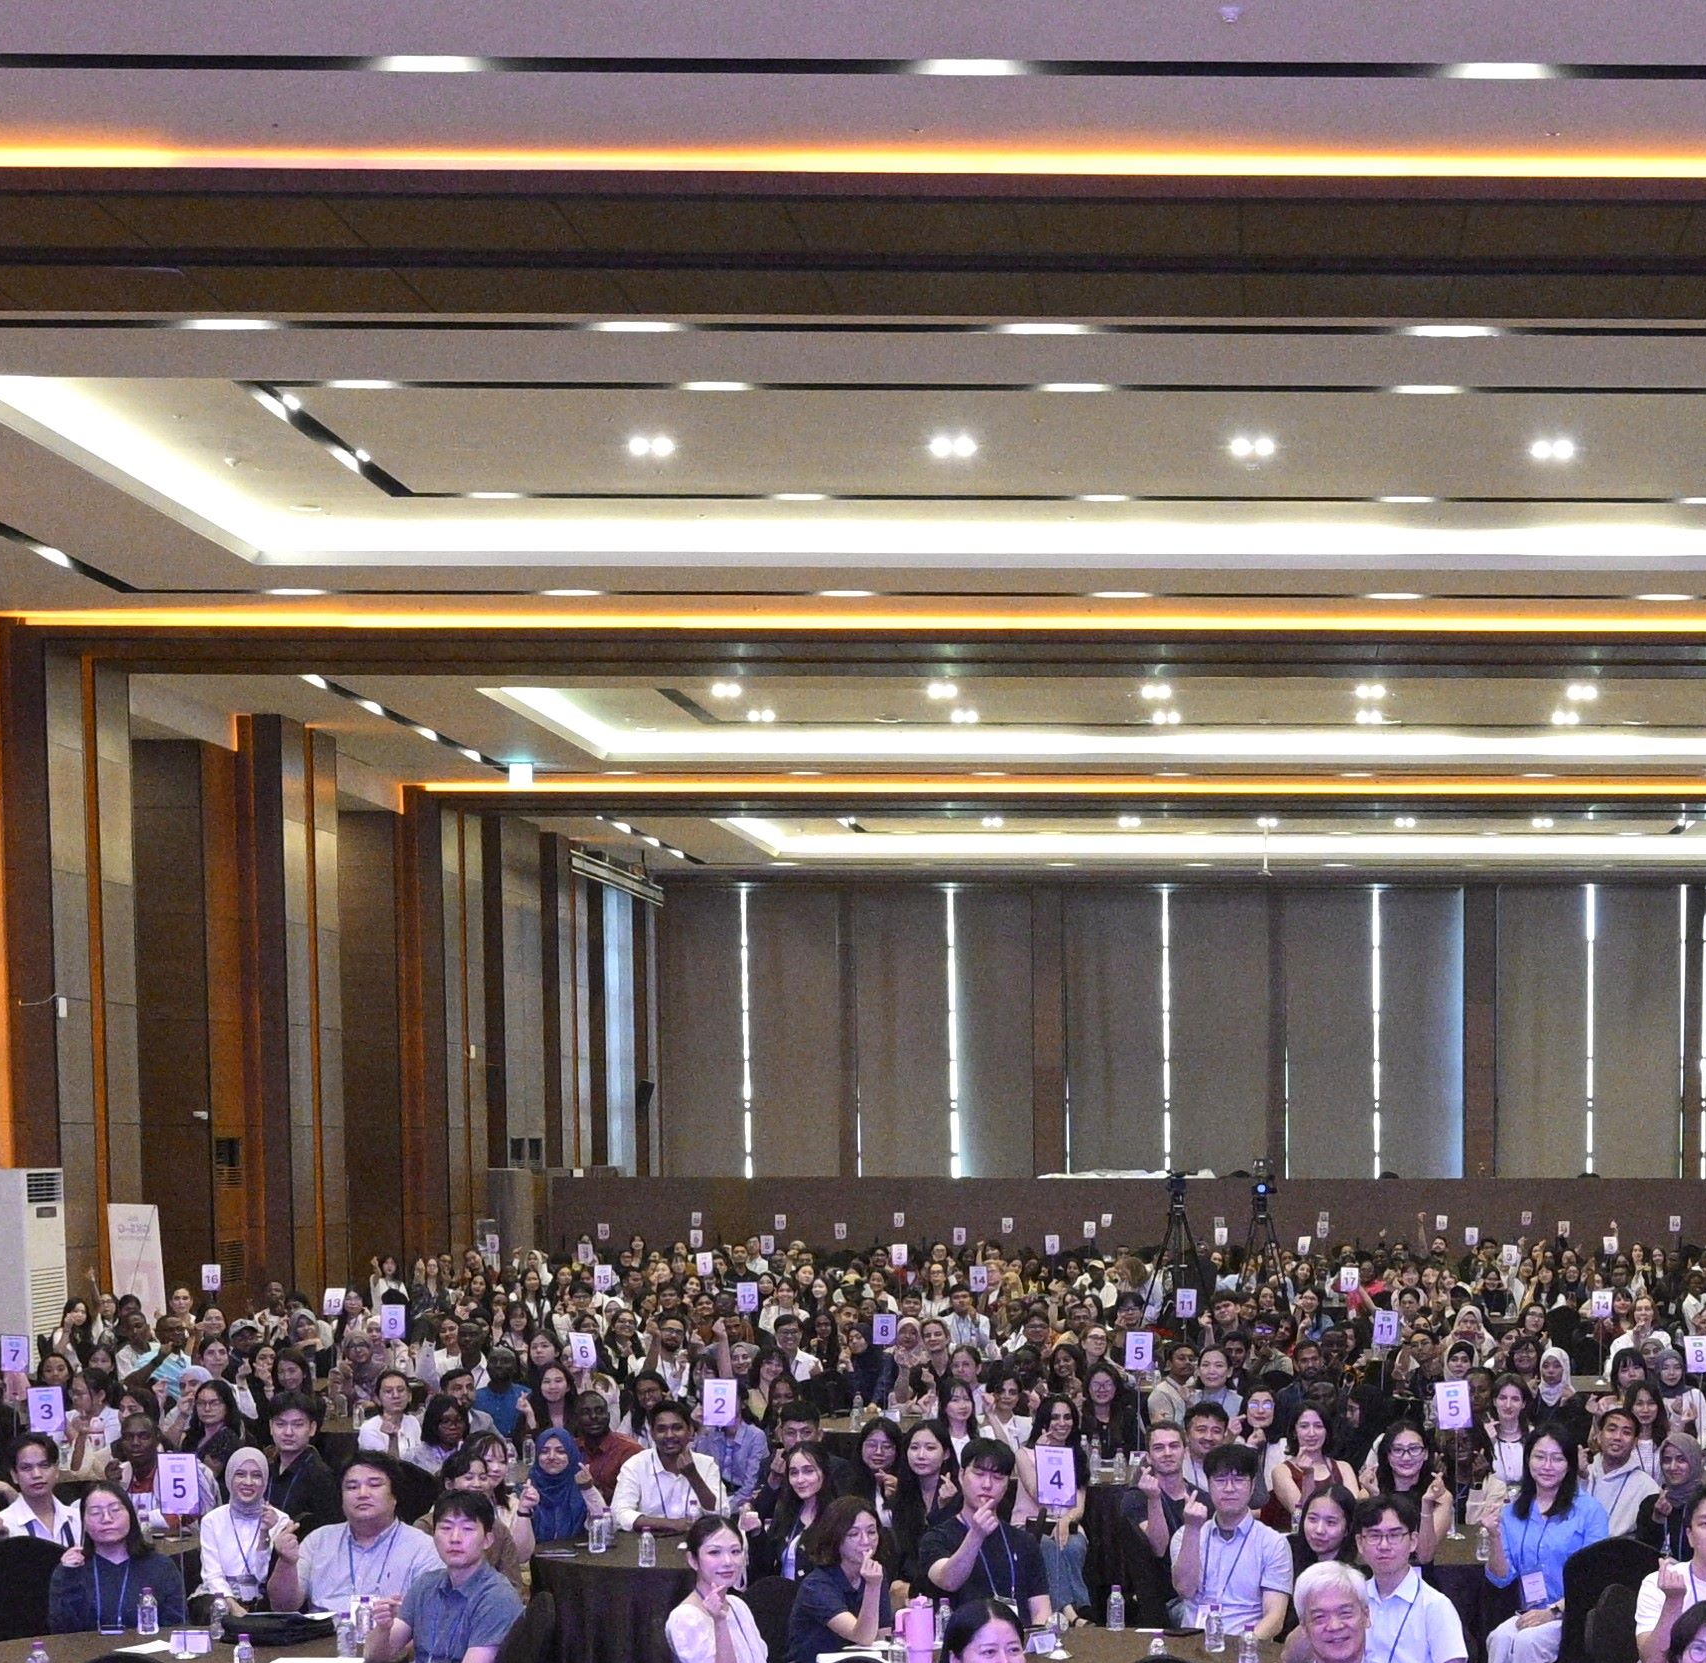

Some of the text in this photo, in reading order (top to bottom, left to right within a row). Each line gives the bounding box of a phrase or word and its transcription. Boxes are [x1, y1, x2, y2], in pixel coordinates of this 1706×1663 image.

[702, 1262, 706, 1270] 1
[206, 1275, 218, 1284] 16
[597, 1274, 610, 1285] 15
[973, 1276, 985, 1284] 14
[1344, 1277, 1356, 1286] 17
[327, 1299, 340, 1309] 13
[741, 1294, 755, 1305] 12
[1180, 1301, 1192, 1310] 11
[1596, 1302, 1608, 1310] 14
[389, 1318, 397, 1330] 9
[1378, 1324, 1392, 1335] 11
[880, 1326, 888, 1336] 8
[10, 1349, 19, 1361] 7
[580, 1346, 588, 1358] 6
[1134, 1347, 1143, 1360] 5
[1695, 1350, 1704, 1362] 8
[41, 1404, 53, 1419] 3
[714, 1398, 725, 1414] 2
[1449, 1401, 1459, 1416] 5
[1050, 1470, 1063, 1489] 4
[173, 1478, 186, 1498] 5
